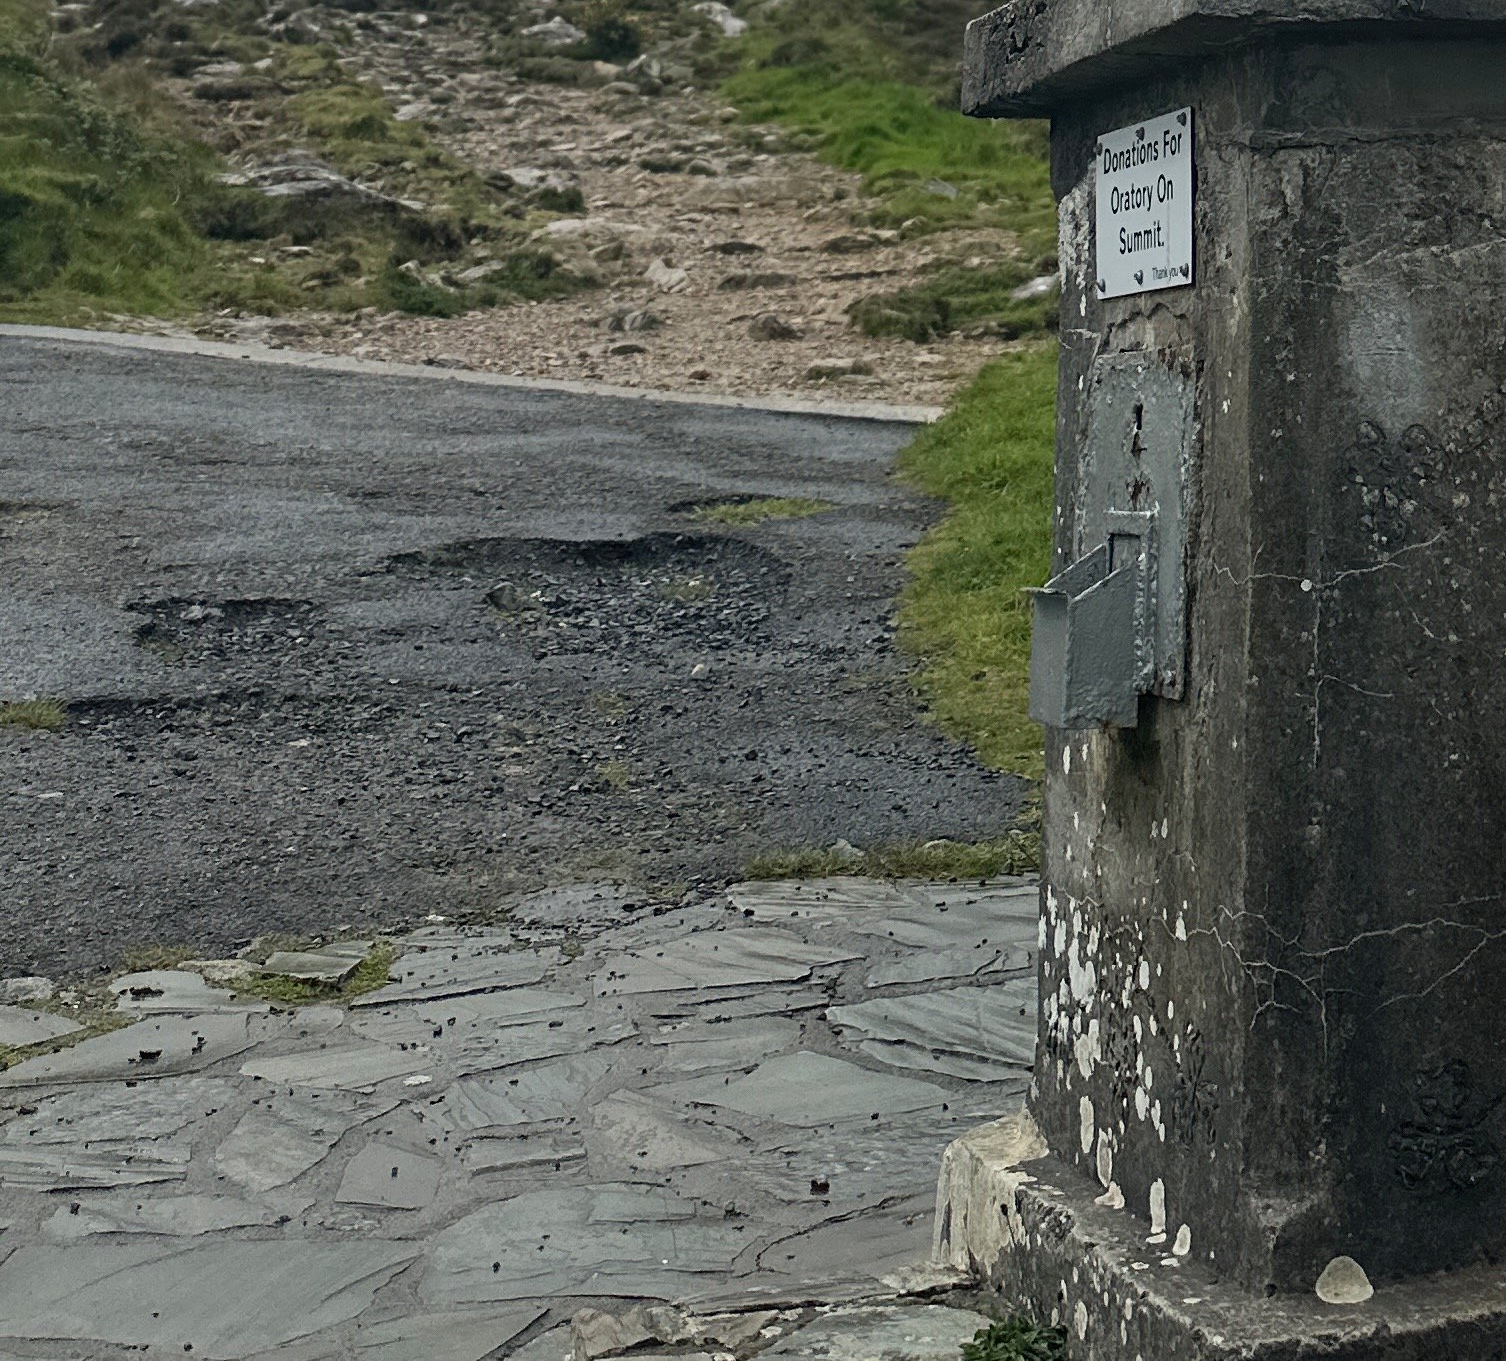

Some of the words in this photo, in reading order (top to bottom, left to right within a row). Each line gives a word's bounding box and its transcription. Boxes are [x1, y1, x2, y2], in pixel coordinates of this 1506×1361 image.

[1103, 140, 1159, 174] Donations
[1163, 129, 1182, 159] For
[1111, 183, 1153, 215] Oratory
[1157, 173, 1173, 203] On
[1119, 220, 1164, 254] Summit.
[1152, 266, 1168, 280] Thank
[1168, 267, 1178, 282] you
